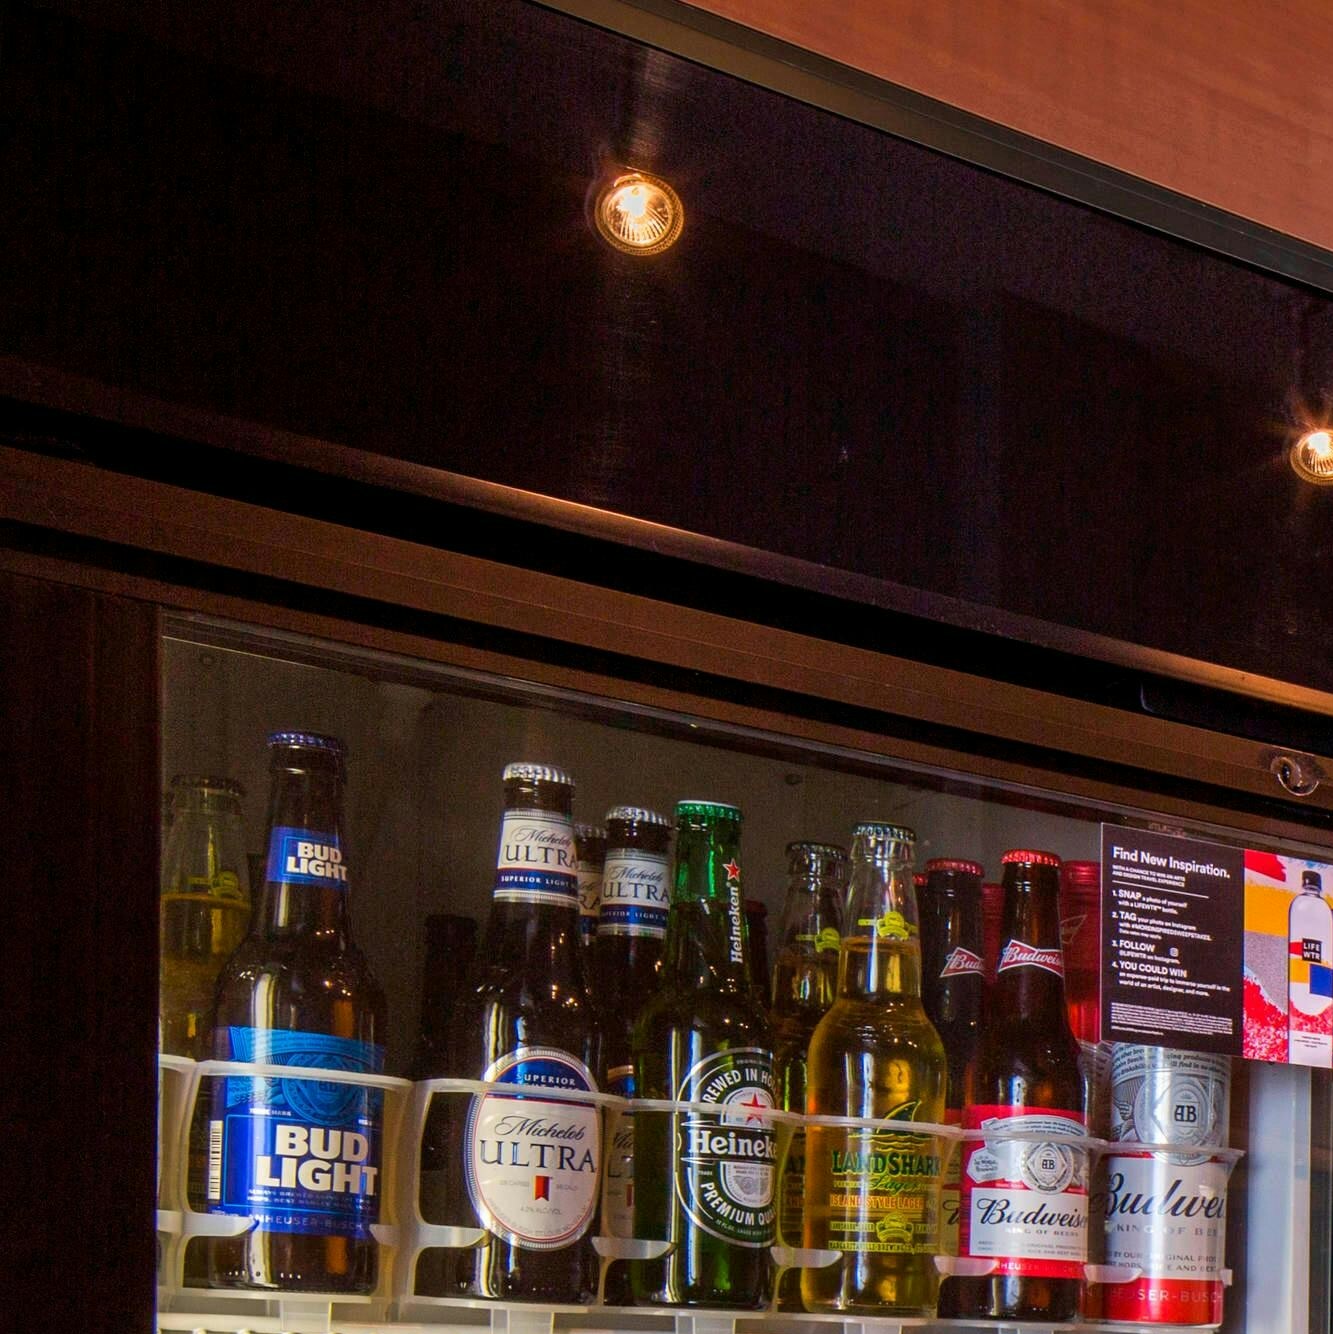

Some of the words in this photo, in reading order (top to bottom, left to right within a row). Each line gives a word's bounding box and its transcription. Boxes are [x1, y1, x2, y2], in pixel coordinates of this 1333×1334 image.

[512, 827, 571, 848] Michelob
[298, 842, 342, 862] BUD
[506, 845, 577, 869] ULTRA
[286, 856, 347, 881] LIGHT
[1112, 846, 1138, 862] Find
[1140, 851, 1167, 867] New
[1169, 856, 1231, 879] Inspiration.
[501, 875, 541, 884] SUPERIOR
[604, 882, 669, 901] ULTRA
[1119, 889, 1141, 900] SNAP
[729, 886, 743, 964] Heineken
[1121, 911, 1136, 921] TAG
[1003, 947, 1060, 964] Budweis
[1120, 940, 1155, 952] FOLLOW
[1303, 942, 1320, 951] LIFE
[1303, 951, 1320, 960] WTR
[1120, 961, 1137, 970] YOU
[1139, 964, 1168, 975] COULD
[1170, 969, 1188, 978] WIN
[516, 1074, 576, 1086] SUPERIOR
[745, 1068, 758, 1082] IN
[495, 1115, 585, 1141] Michelob
[275, 1124, 369, 1162] BUD
[688, 1130, 777, 1157] Heinek
[480, 1139, 596, 1173] ULTRA
[256, 1155, 377, 1196] LIGHT
[700, 1182, 754, 1226] PREMIUM
